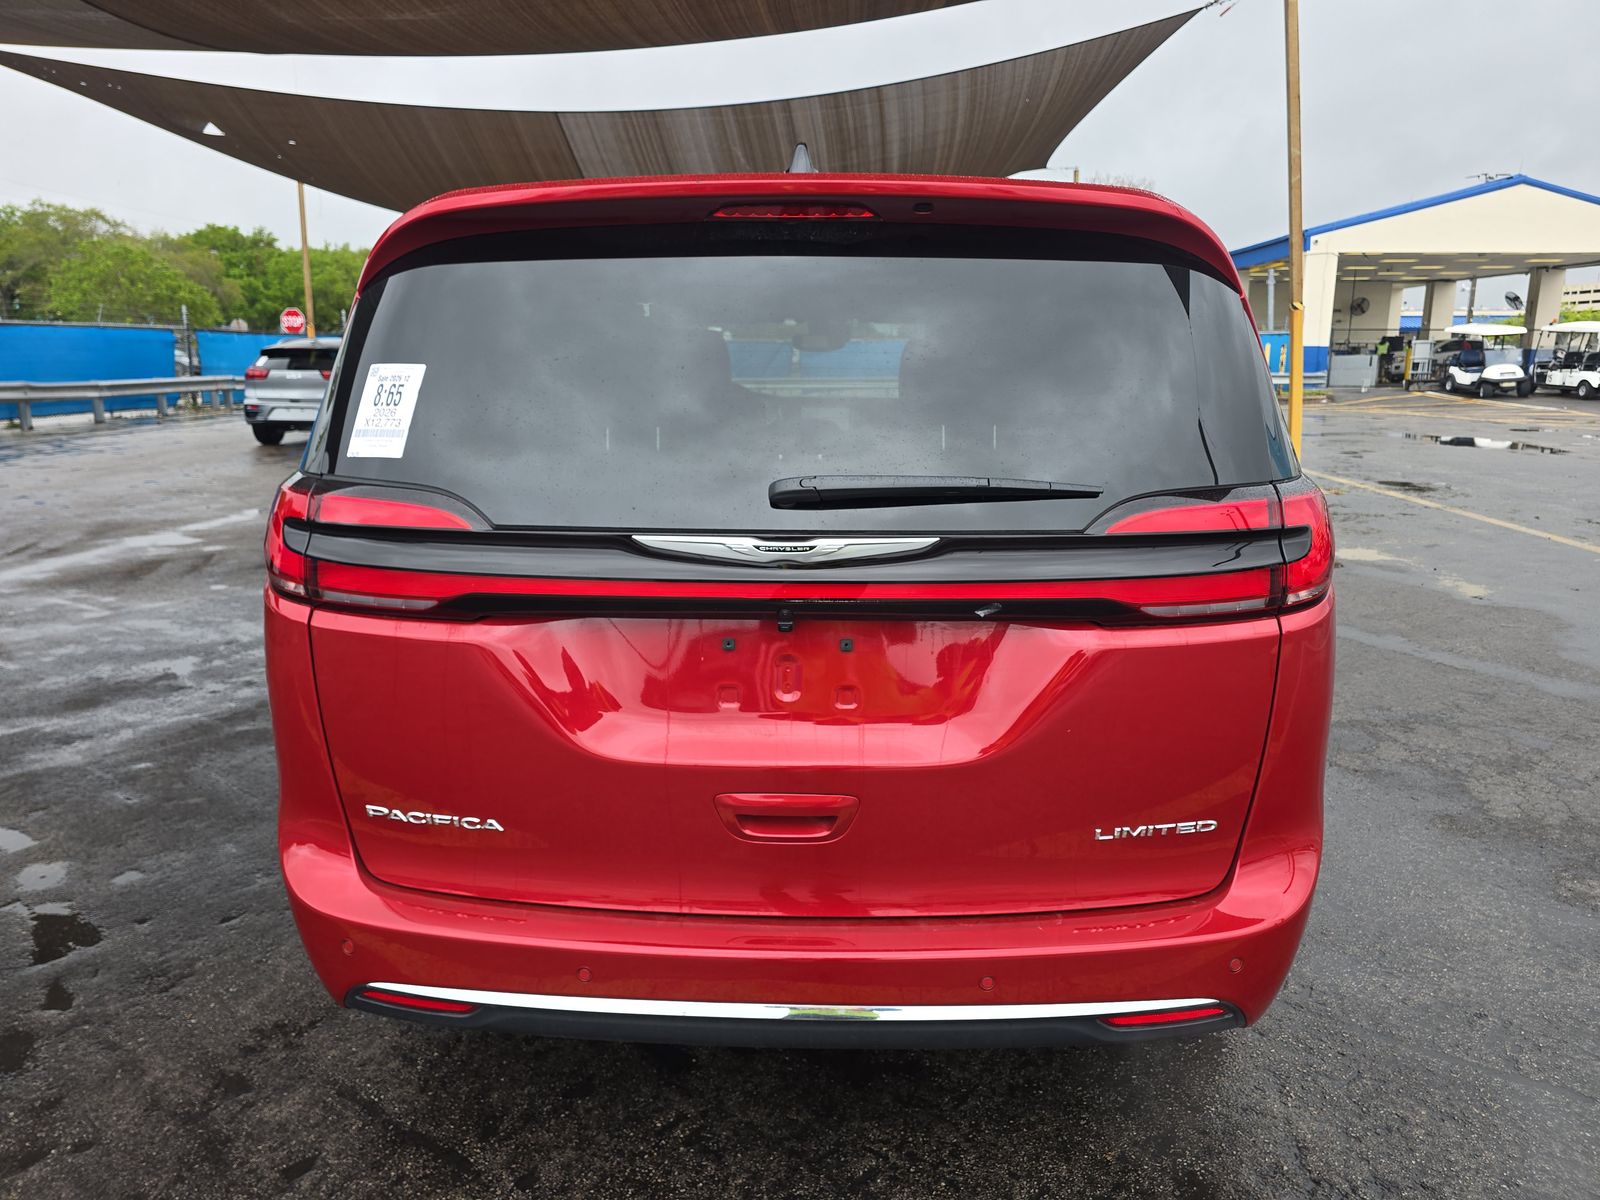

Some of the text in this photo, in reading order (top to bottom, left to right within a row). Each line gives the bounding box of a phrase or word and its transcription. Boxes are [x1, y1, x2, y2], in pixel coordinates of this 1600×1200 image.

[373, 383, 405, 407] 8:65
[373, 408, 398, 418] 2026
[365, 804, 505, 832] PACIFICA
[1095, 820, 1218, 840] LIMITED
